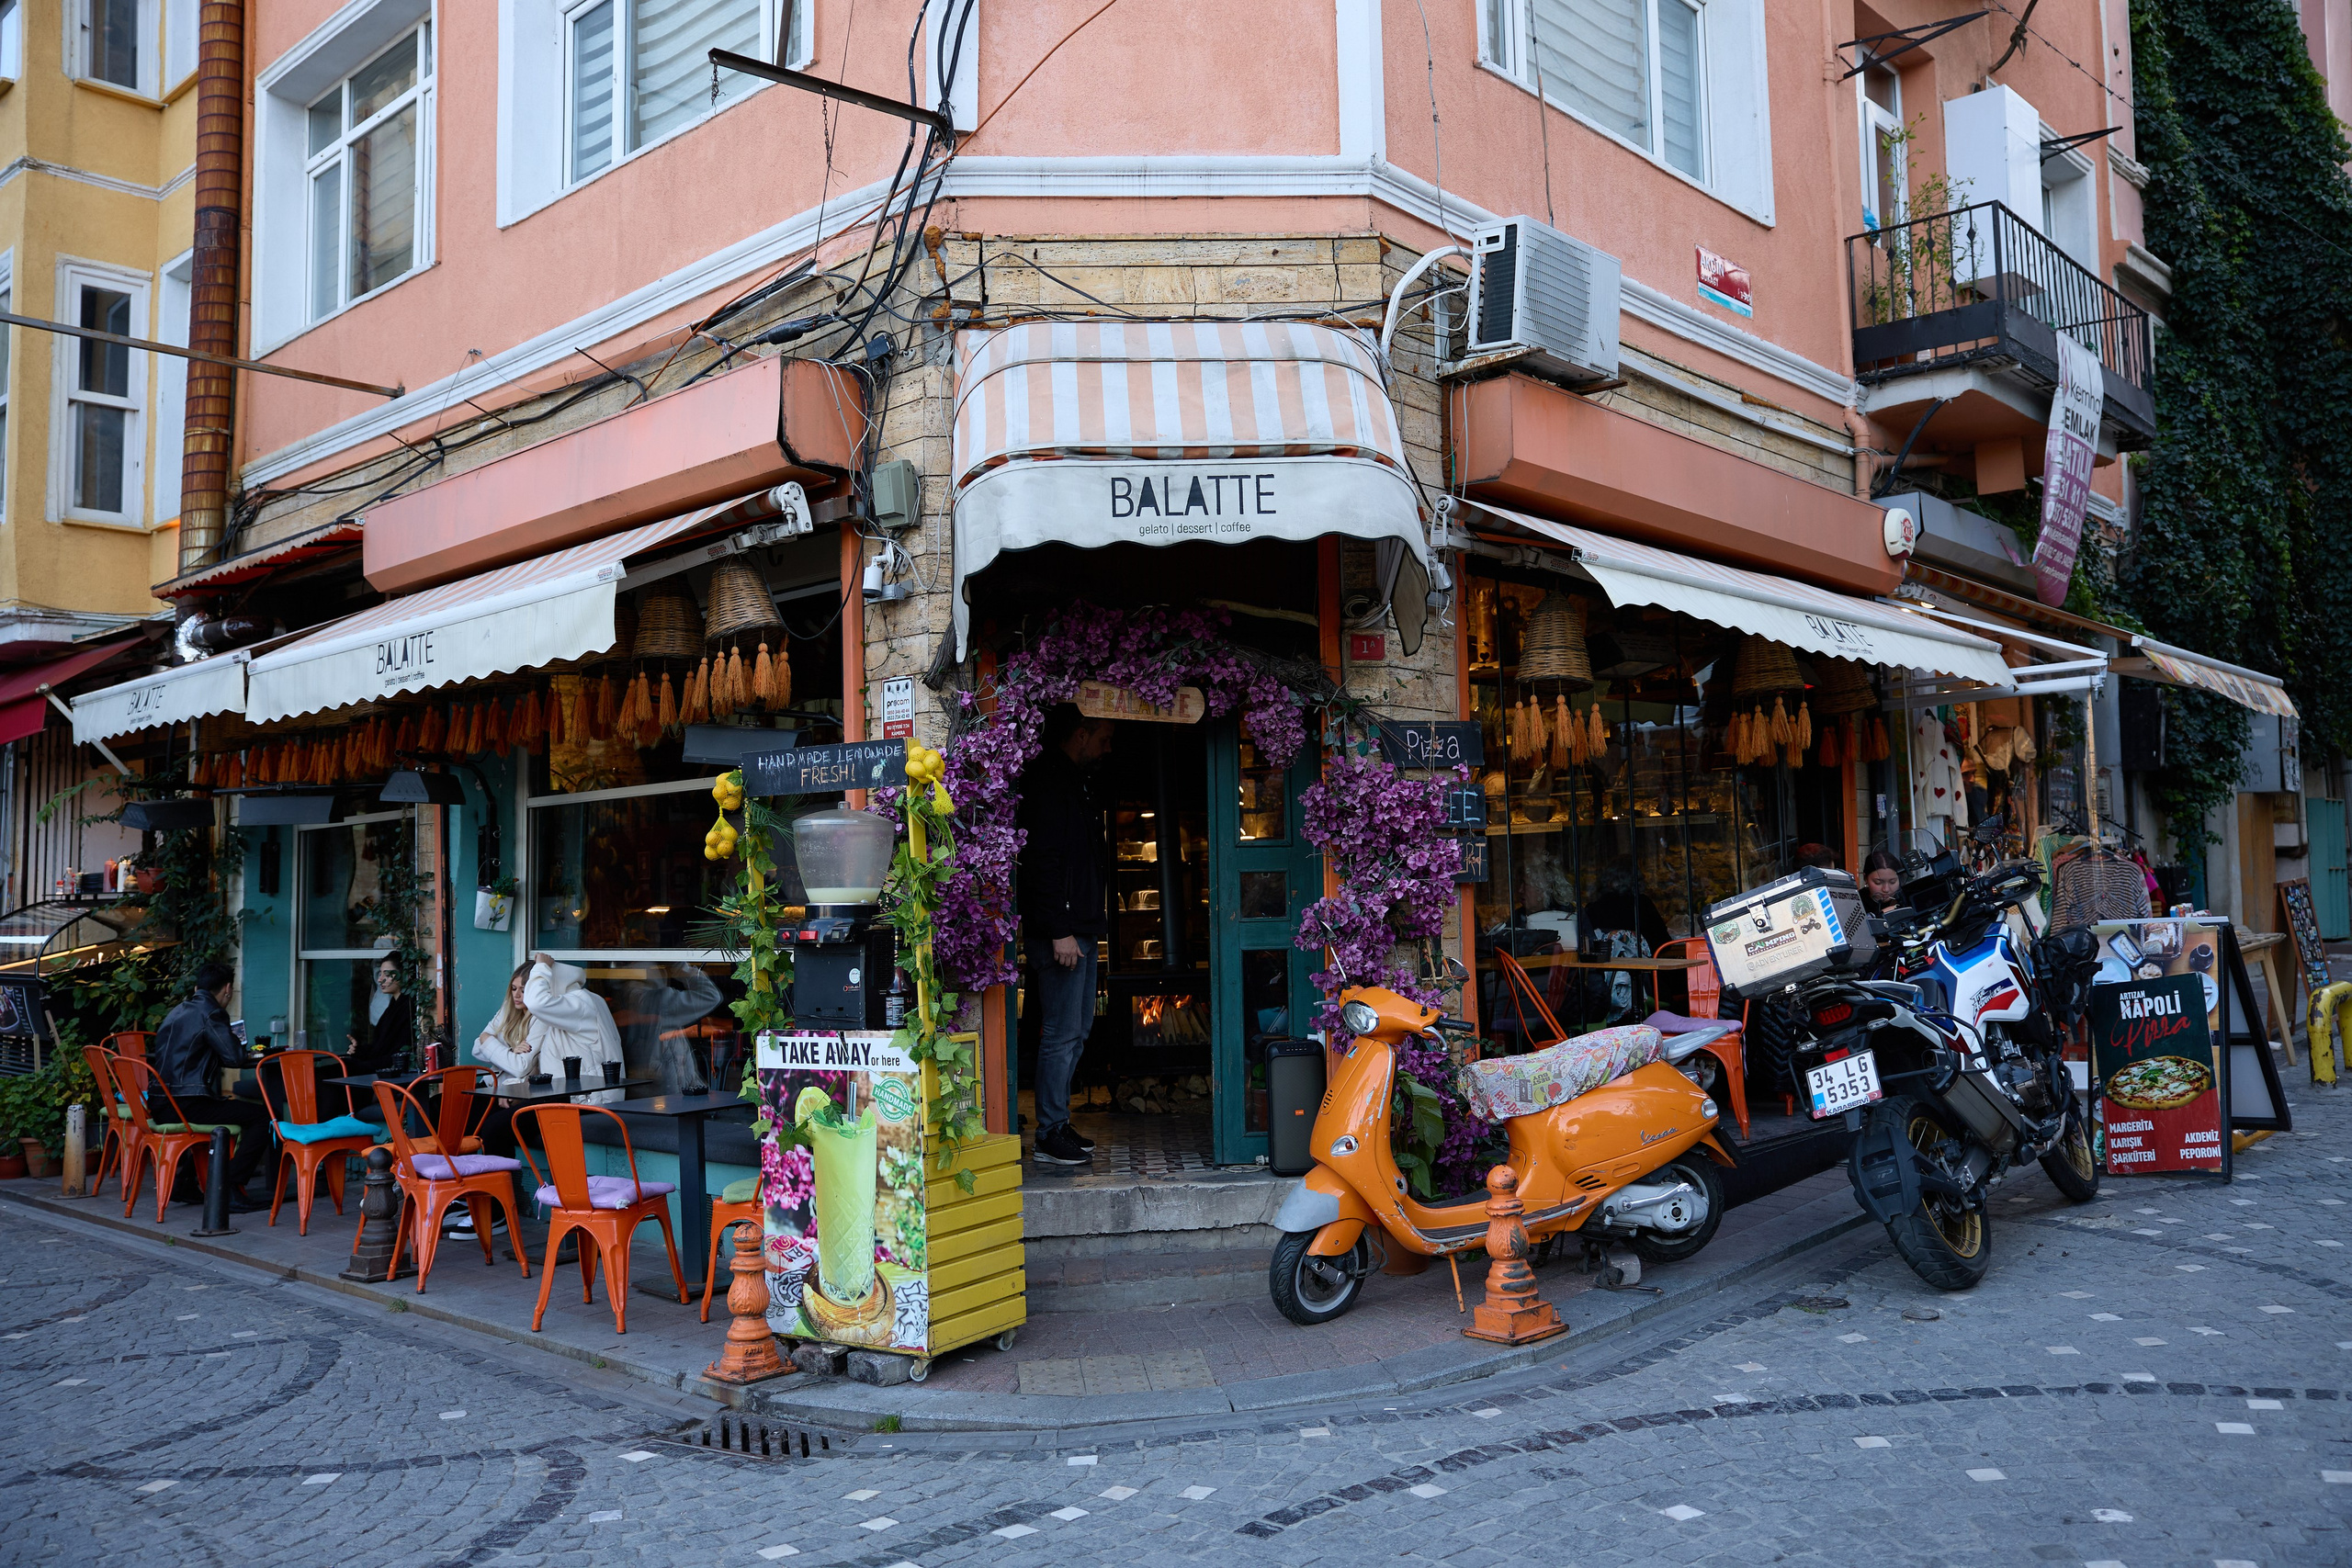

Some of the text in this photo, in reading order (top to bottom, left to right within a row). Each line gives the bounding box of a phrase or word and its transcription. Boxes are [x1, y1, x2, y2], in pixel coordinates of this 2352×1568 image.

[2064, 406, 2097, 446] EMLAK
[1111, 473, 1276, 518] BALATTE
[1139, 521, 1251, 536] gelato dessert coffee
[1804, 615, 1874, 647] BALATTE
[376, 630, 435, 674] BALATTE
[127, 685, 166, 716] BALATTE
[1407, 730, 1461, 761] Pizza
[800, 763, 856, 787] FRESH!
[2120, 990, 2146, 1001] ARTIZAN
[2120, 990, 2182, 1020] NAPOLİ
[2109, 1002, 2191, 1056] Pizza
[779, 1041, 900, 1066] TAKE AWAY or here
[1813, 1055, 1869, 1089] 34 LG
[874, 1088, 913, 1114] HANDMADE
[1826, 1075, 1871, 1104] 5353
[2109, 1119, 2154, 1134] MARGERİTA
[2185, 1129, 2220, 1144] AKDENİZ
[2110, 1136, 2143, 1149] KARIŞIK
[2180, 1144, 2222, 1159] PEPORONİ
[2112, 1148, 2156, 1166] ŞARKÜTERİ
